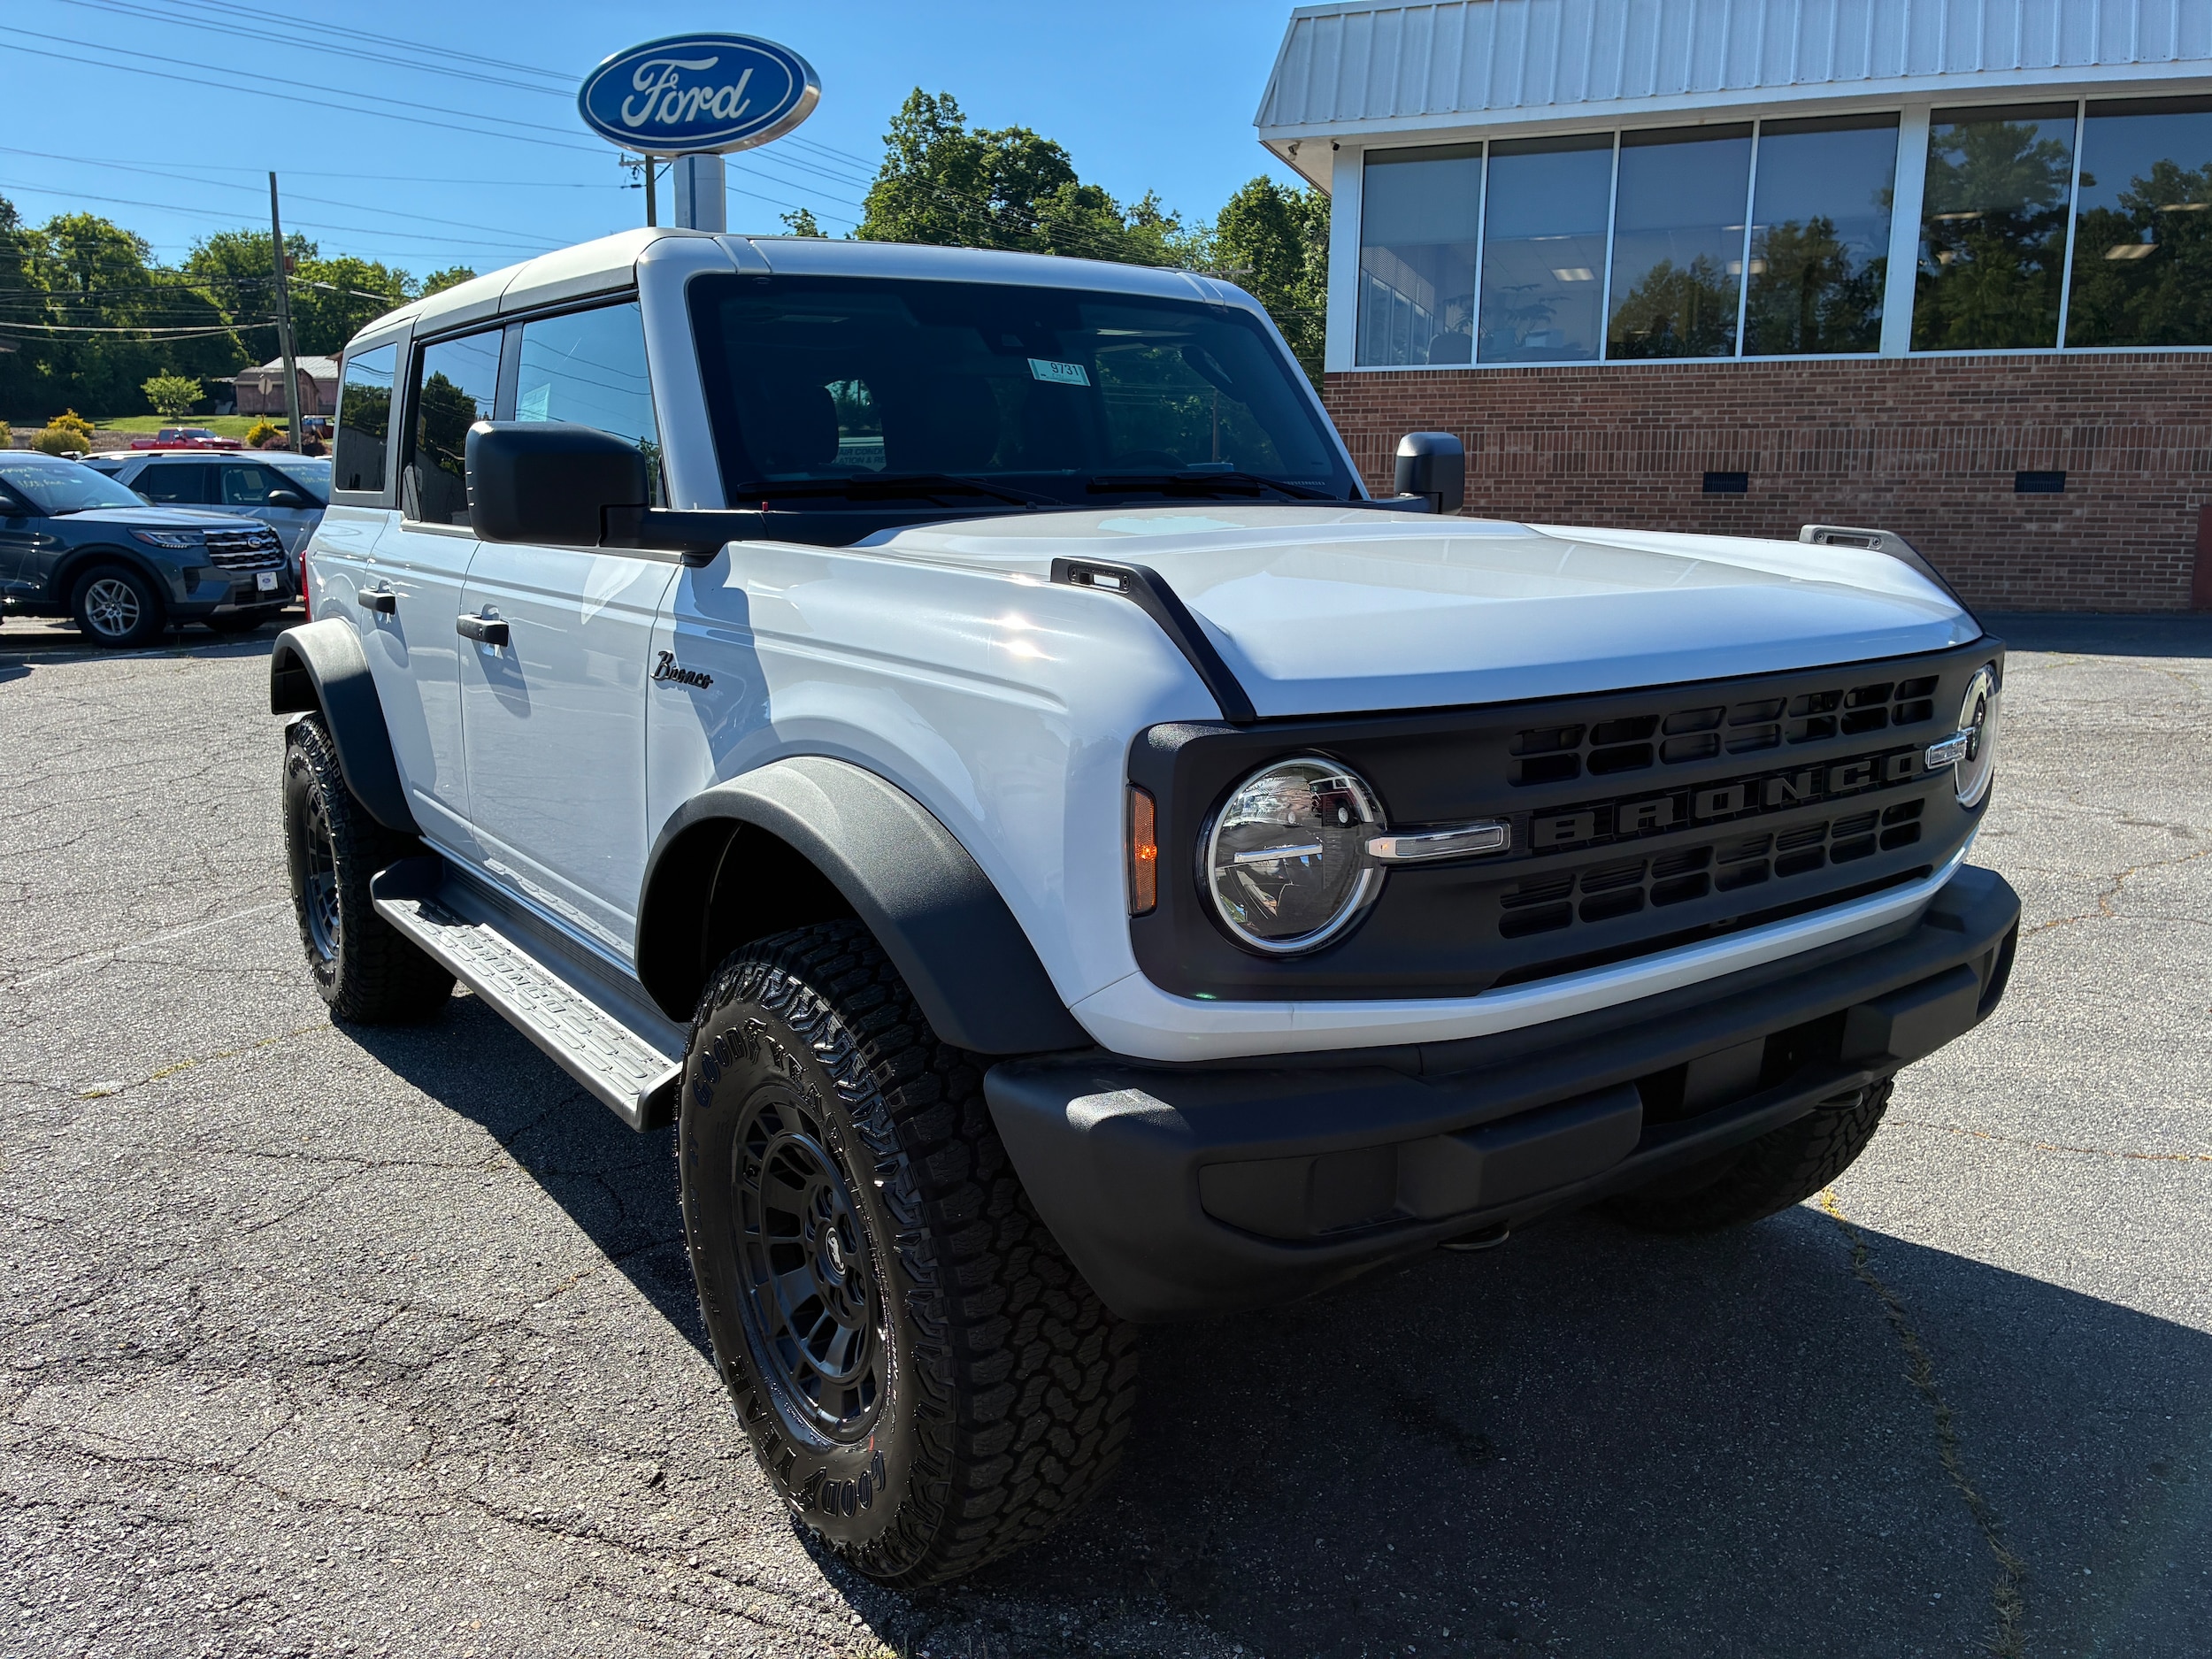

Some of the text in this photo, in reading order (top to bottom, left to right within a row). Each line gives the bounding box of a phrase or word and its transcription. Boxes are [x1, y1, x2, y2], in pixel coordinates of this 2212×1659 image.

[621, 56, 754, 127] Ford
[1050, 362, 1079, 376] 9731
[650, 649, 714, 689] Bronco
[1532, 749, 1924, 849] BRONCO
[461, 937, 567, 1013] BRONCO
